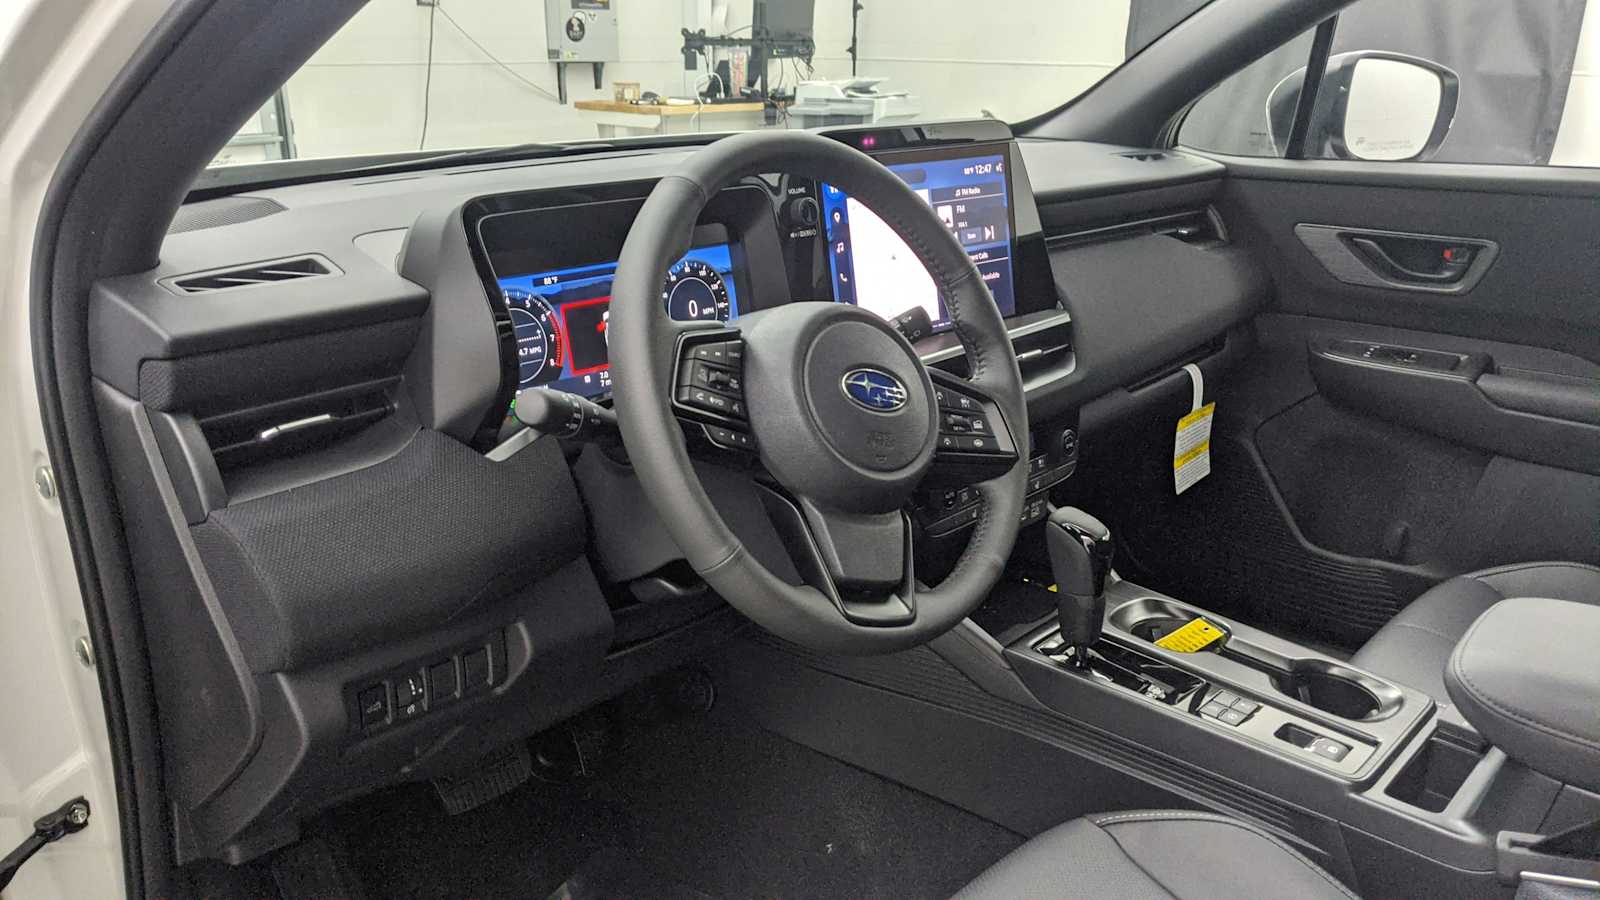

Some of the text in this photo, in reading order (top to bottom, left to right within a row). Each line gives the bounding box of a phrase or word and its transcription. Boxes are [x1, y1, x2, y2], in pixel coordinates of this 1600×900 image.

[975, 163, 992, 175] 12:47
[787, 186, 806, 195] VOLUME
[968, 186, 981, 194] Radio
[956, 204, 966, 214] FM
[525, 300, 531, 308] 5
[688, 300, 715, 318] 0 MPH
[541, 313, 547, 322] 6
[529, 346, 542, 354] MPG
[549, 358, 555, 367] 8
